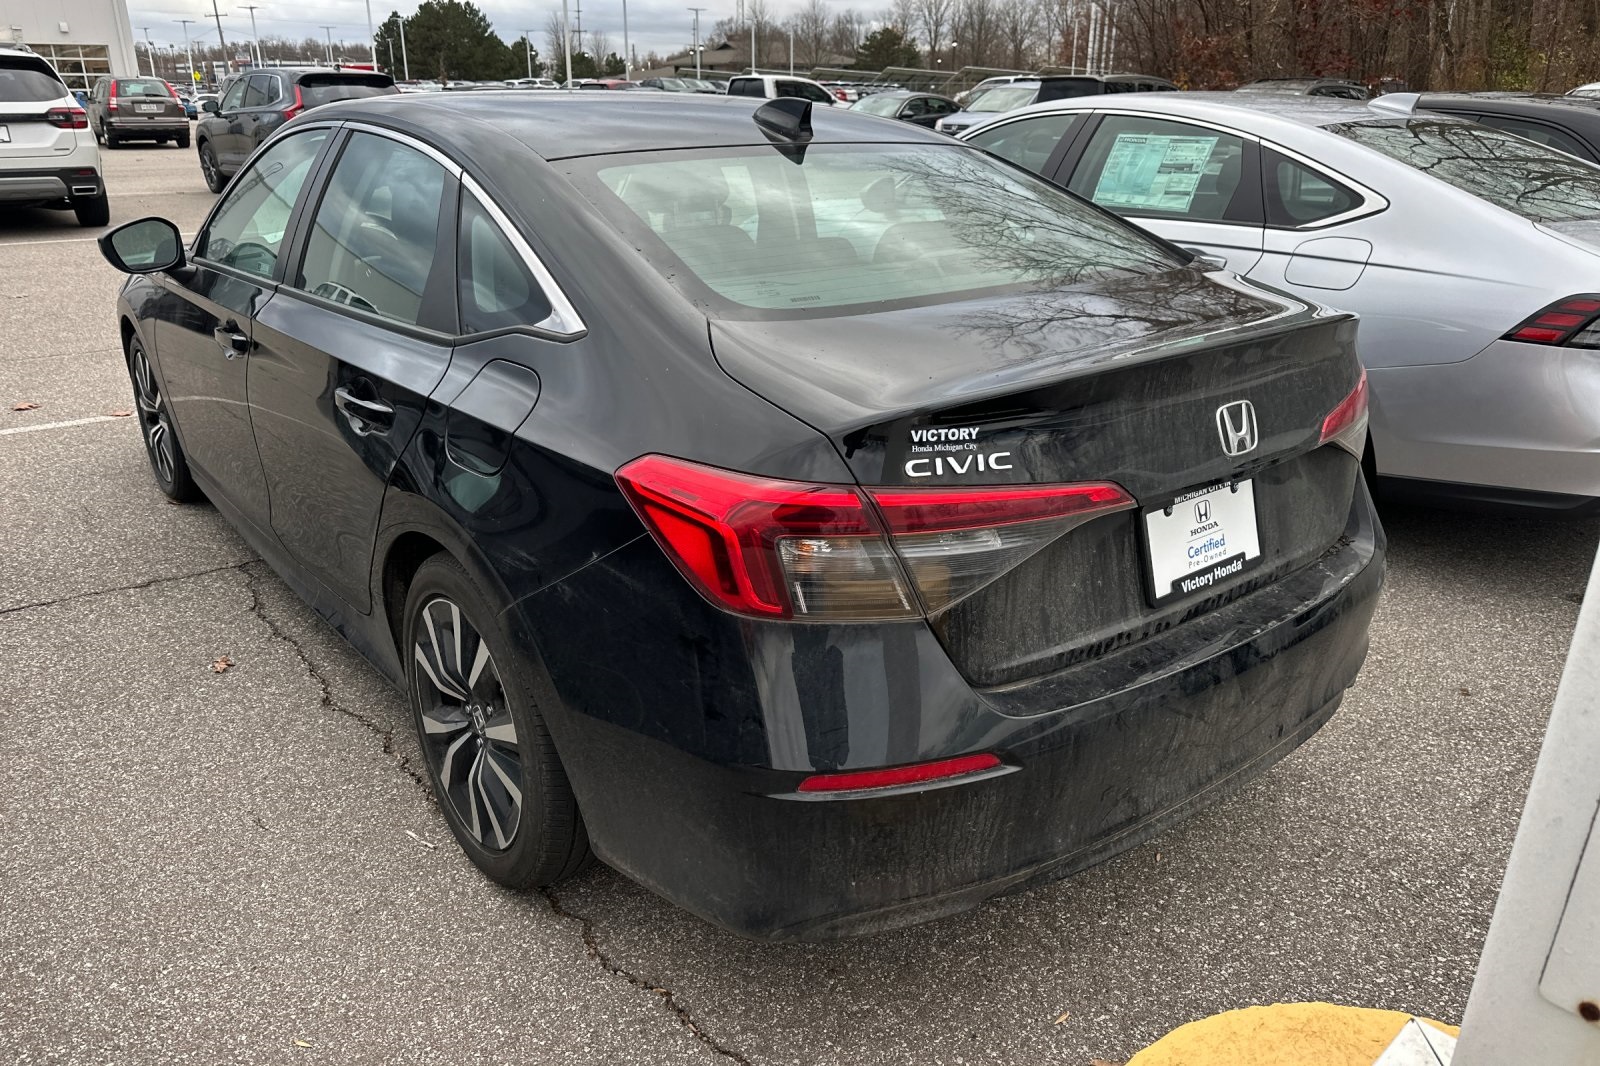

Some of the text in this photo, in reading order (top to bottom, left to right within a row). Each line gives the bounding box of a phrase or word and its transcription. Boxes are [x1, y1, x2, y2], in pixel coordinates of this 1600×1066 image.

[911, 427, 980, 442] VICTORY
[912, 443, 977, 453] Honda Michigan City
[905, 452, 1012, 477] CIVIC
[1174, 488, 1207, 504] MICHIGAN
[1190, 521, 1219, 537] HONDA
[1187, 534, 1226, 559] Certified
[1188, 548, 1227, 569] Pre-Owned
[1181, 572, 1214, 593] Victory
